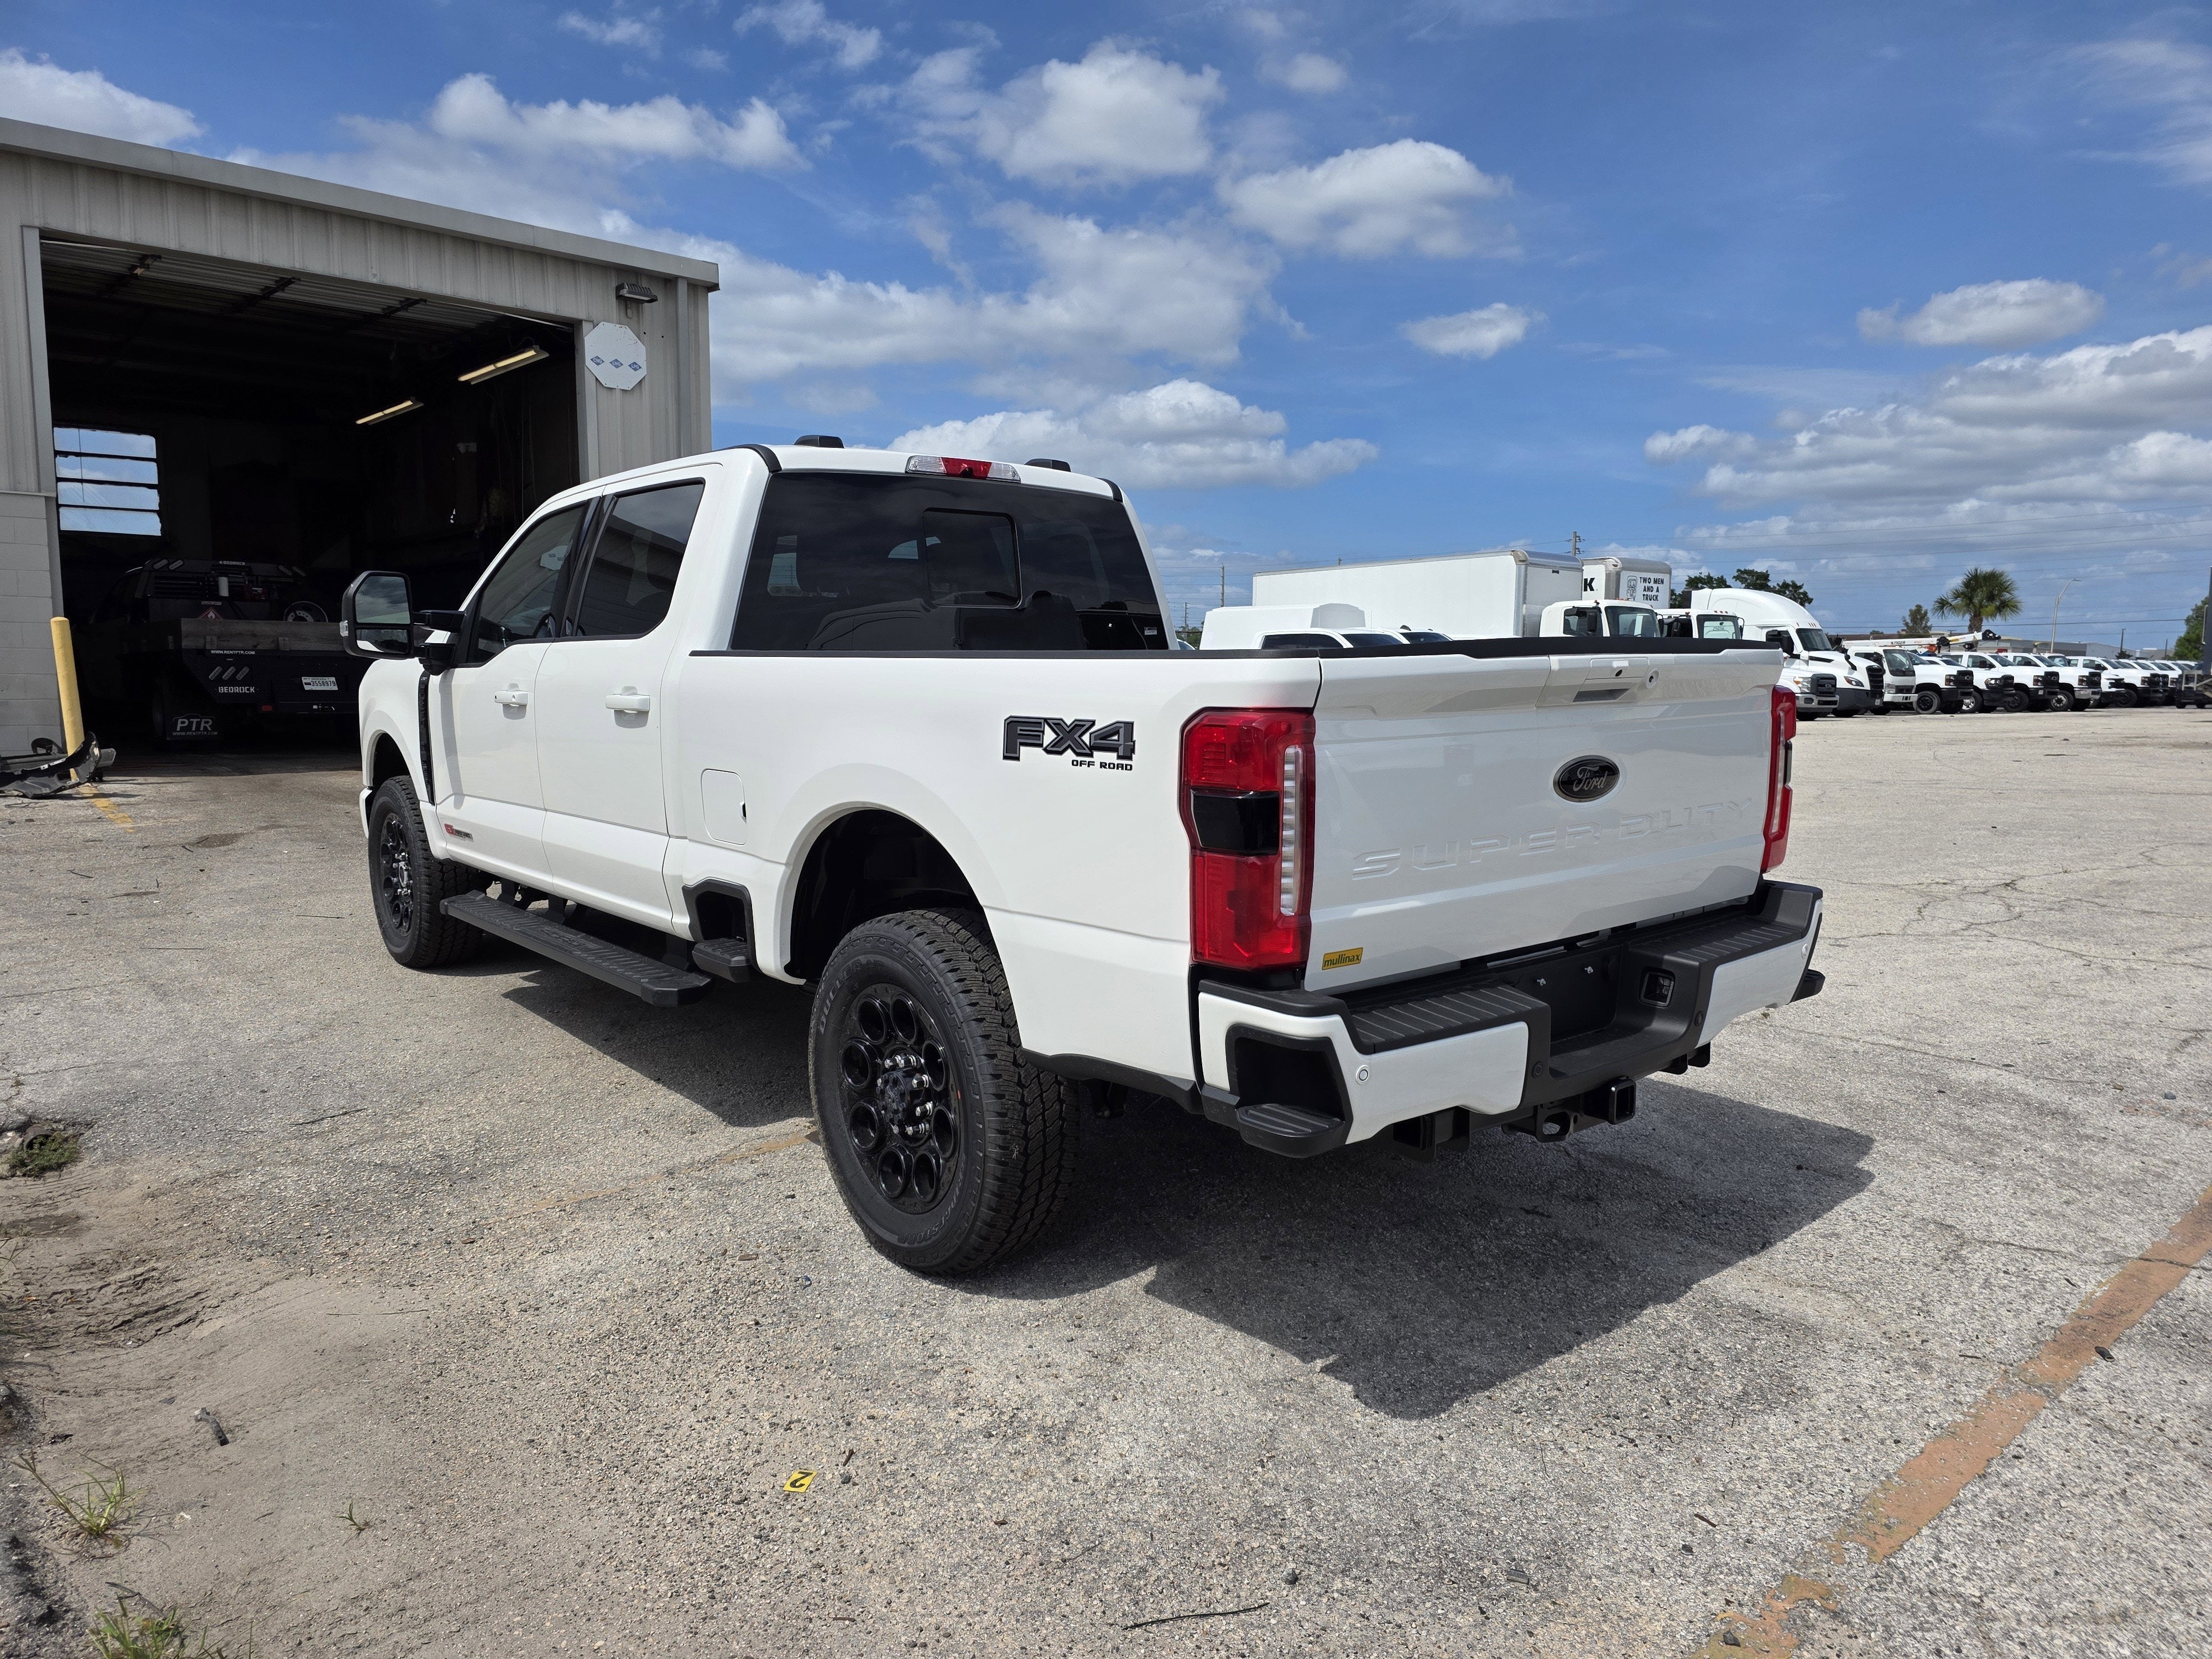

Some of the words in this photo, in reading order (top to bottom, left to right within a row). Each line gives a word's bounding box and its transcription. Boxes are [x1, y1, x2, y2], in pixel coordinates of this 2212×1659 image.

[177, 718, 212, 731] PTR
[1003, 715, 1135, 761] FX4
[1071, 759, 1095, 768] OFF
[1099, 761, 1133, 771] ROAD
[1573, 766, 1608, 792] Ford
[1352, 821, 1603, 880] SUPER
[1619, 798, 1752, 840] DUTY
[1324, 954, 1360, 967] mullinax
